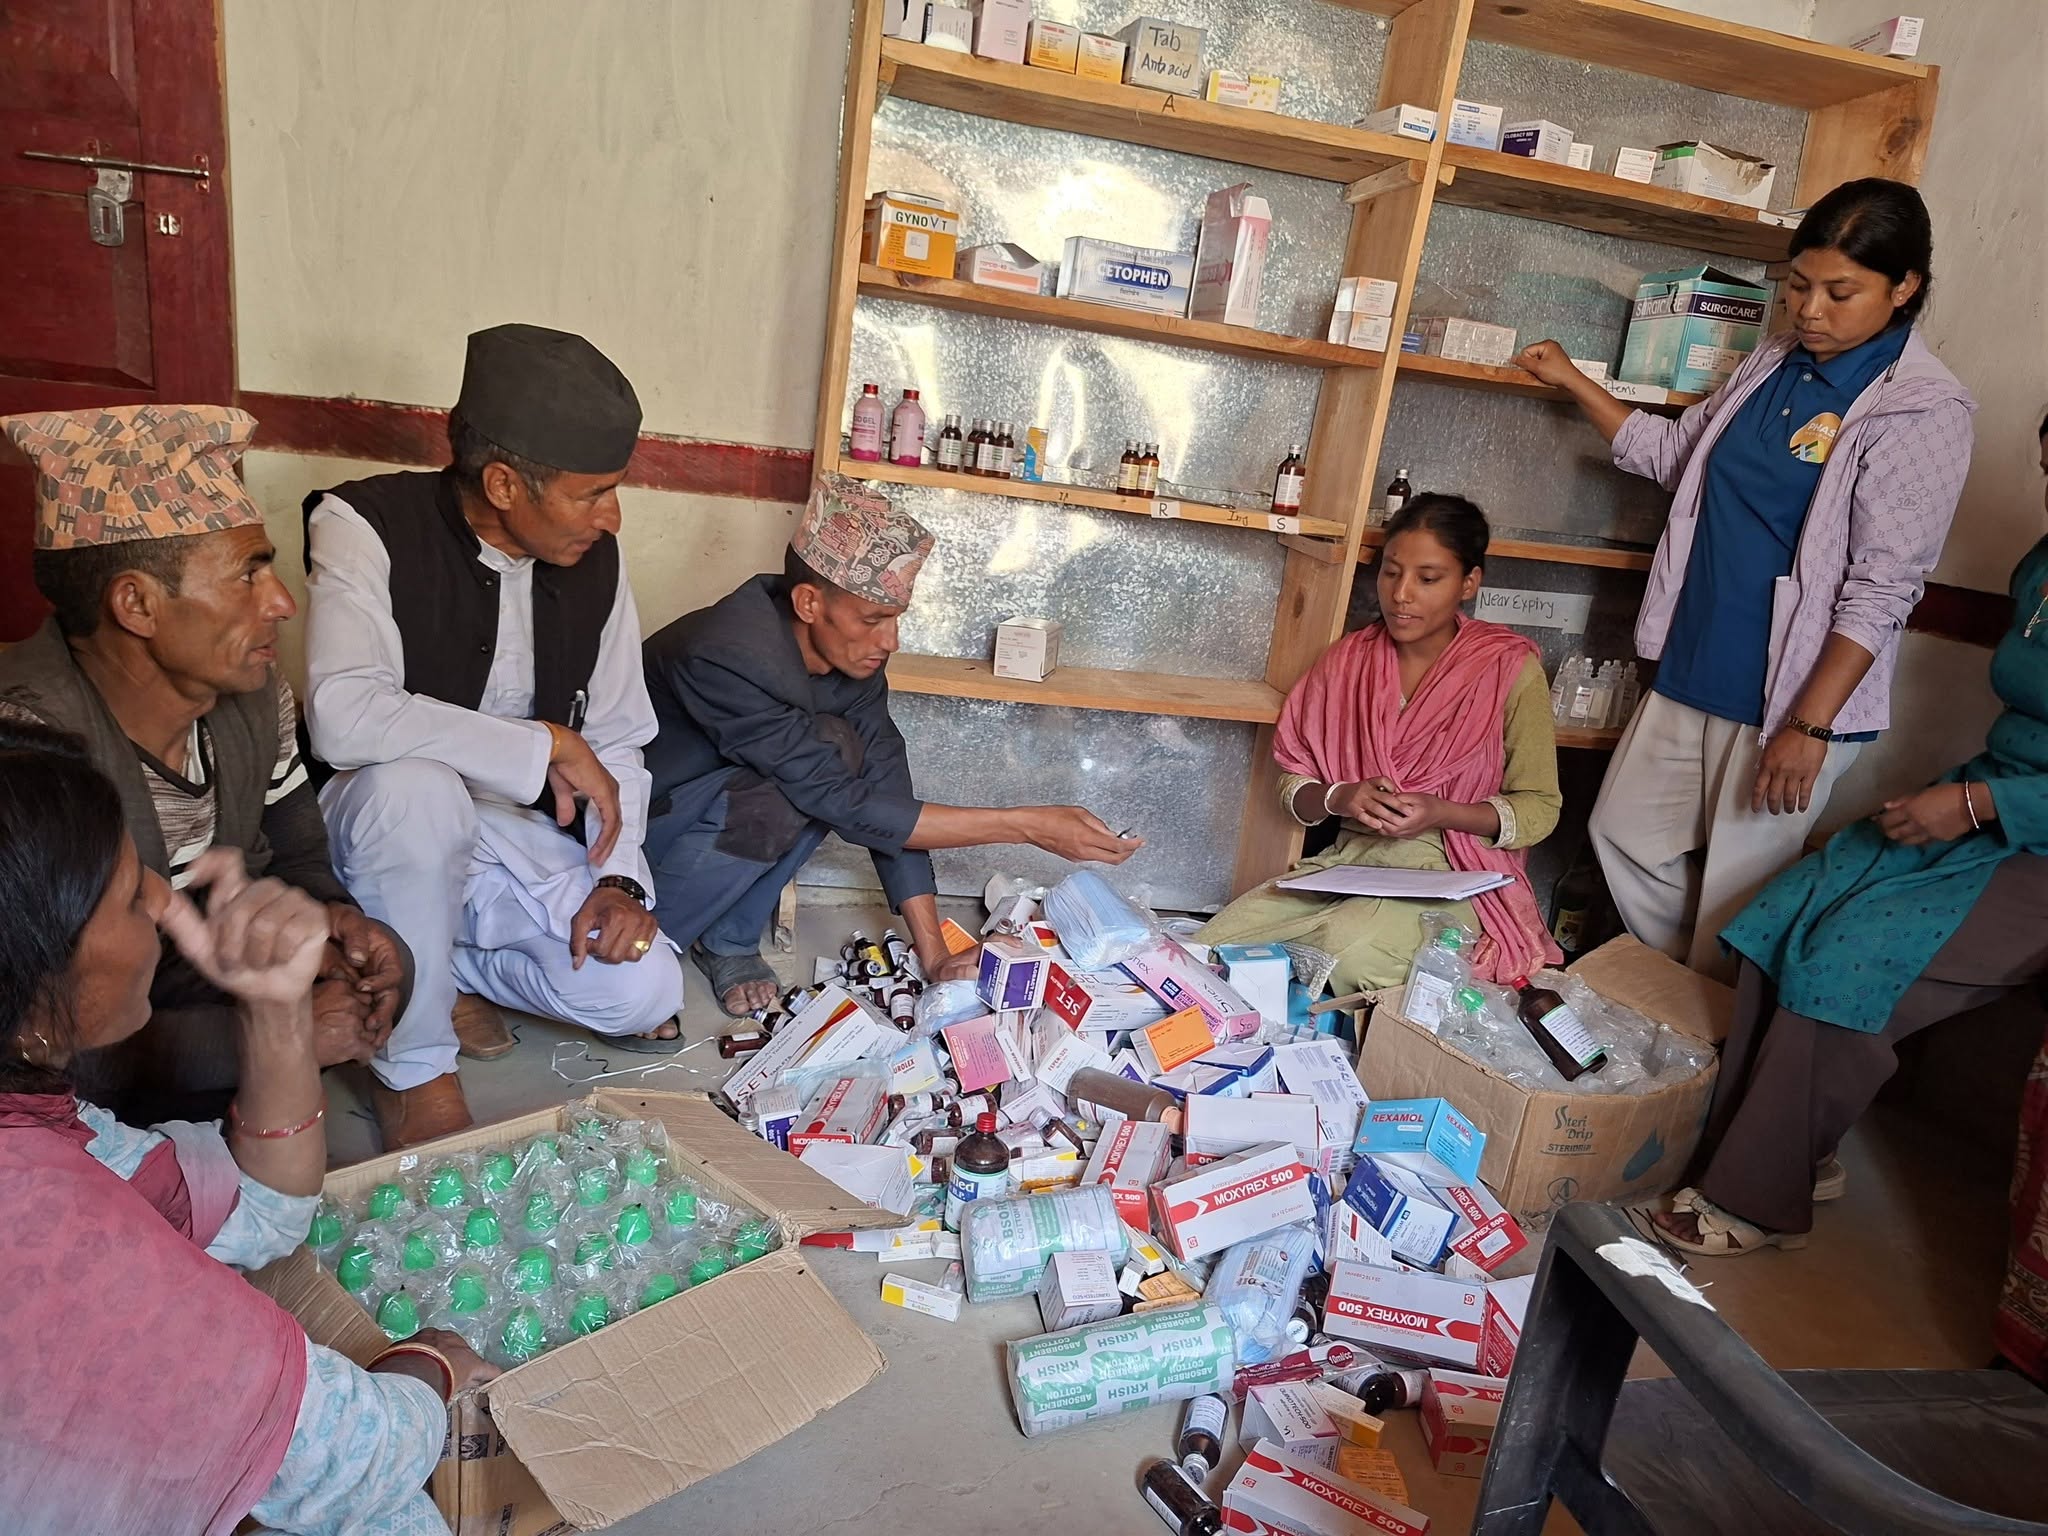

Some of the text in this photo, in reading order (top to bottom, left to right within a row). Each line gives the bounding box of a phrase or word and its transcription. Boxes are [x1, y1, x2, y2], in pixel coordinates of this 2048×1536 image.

[1149, 26, 1181, 50] Tab
[1161, 94, 1176, 113] A
[1700, 300, 1758, 319] SURGICARE
[1603, 381, 1636, 395] Items
[1159, 502, 1168, 517] R
[1277, 518, 1286, 530] S
[1480, 592, 1555, 619] Near Expiry
[1030, 961, 1040, 990] CLOBACT
[1056, 991, 1080, 1016] SET
[893, 1059, 915, 1074] UROLEX
[737, 1067, 768, 1101] SET
[1371, 1113, 1425, 1123] REXAMOL
[1446, 1113, 1473, 1141] REXAMOL
[1554, 1105, 1593, 1141] Steri Drip
[1108, 1124, 1132, 1165] MOXYREX 500
[1548, 1143, 1592, 1153] STERIDRIP
[1213, 1169, 1293, 1206] MOXYREX 500
[1467, 1206, 1482, 1221] 500
[1389, 1220, 1404, 1242] PROTIUM
[1458, 1216, 1505, 1251] MOXYREX 500
[1150, 1311, 1201, 1331] ABSORBENT COTTON
[1338, 1300, 1428, 1329] MOXYREX 500
[1361, 1320, 1389, 1333] Capsules
[1029, 1337, 1081, 1359] ABSORBENT COTTON
[1097, 1331, 1139, 1348] KRISH
[1162, 1335, 1203, 1355] KRISH
[1037, 1359, 1079, 1378] KRISH
[1099, 1354, 1150, 1381] ABSORBENT COTTON
[1162, 1359, 1213, 1386] ABSORBENT COTTON
[1038, 1385, 1092, 1412] ABSORBENT COTTON
[1108, 1382, 1149, 1399] KRISH
[1301, 1477, 1407, 1535] MOXYREX 500
